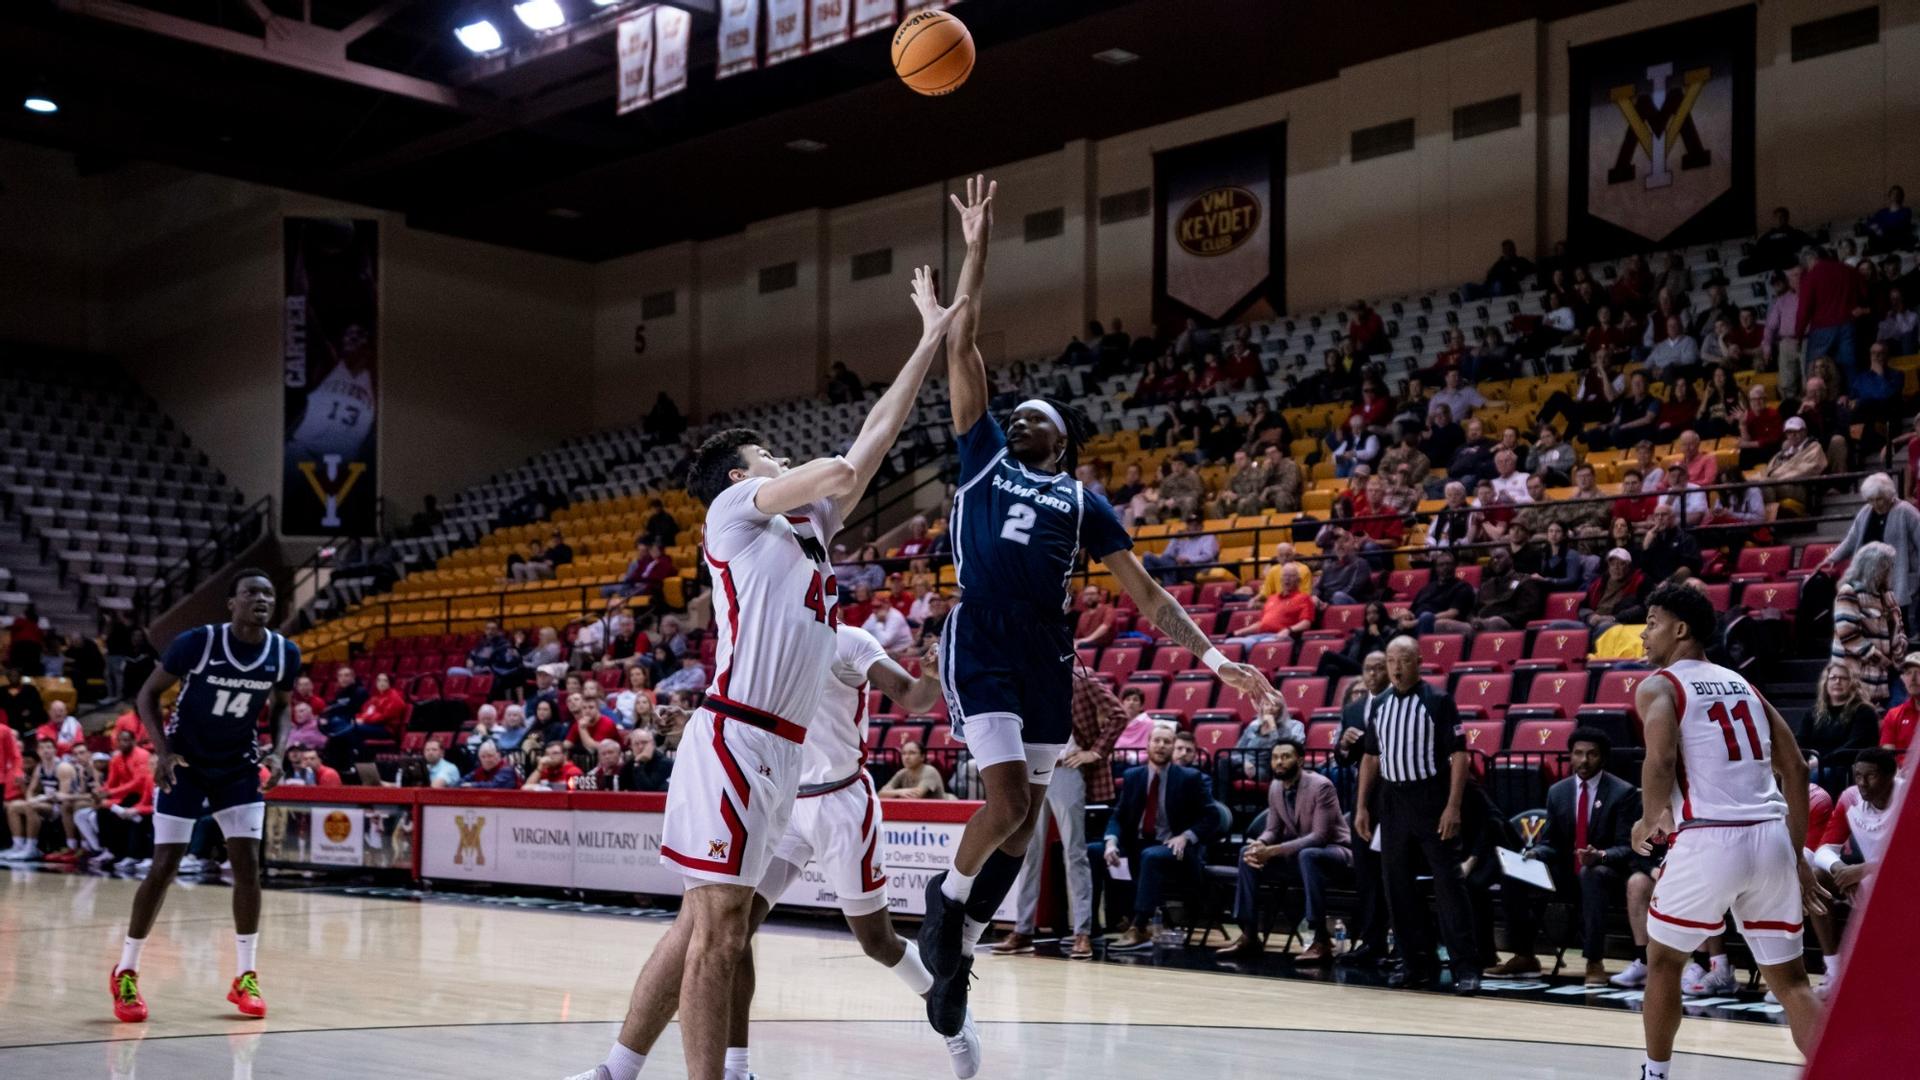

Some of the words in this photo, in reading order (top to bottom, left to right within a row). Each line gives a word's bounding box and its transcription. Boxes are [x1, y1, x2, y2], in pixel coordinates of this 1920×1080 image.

[1201, 189, 1234, 213] VMI
[1181, 204, 1253, 241] KEYDET
[1201, 234, 1233, 252] CLUB
[286, 294, 307, 389] CARTER
[634, 325, 647, 353] 5
[326, 401, 361, 427] 13
[991, 474, 1072, 514] SAMFORD
[1000, 502, 1038, 546] 2
[206, 675, 273, 690] SAMFORD
[1691, 680, 1751, 697] BUTLER
[211, 689, 253, 719] 14
[1706, 699, 1765, 762] 11
[512, 827, 571, 847] VIRGINIA
[576, 830, 639, 851] MILITARY
[884, 825, 950, 848] motive
[893, 850, 913, 863] Over
[914, 851, 926, 864] 50
[926, 853, 950, 865] Years
[892, 873, 906, 889] of
